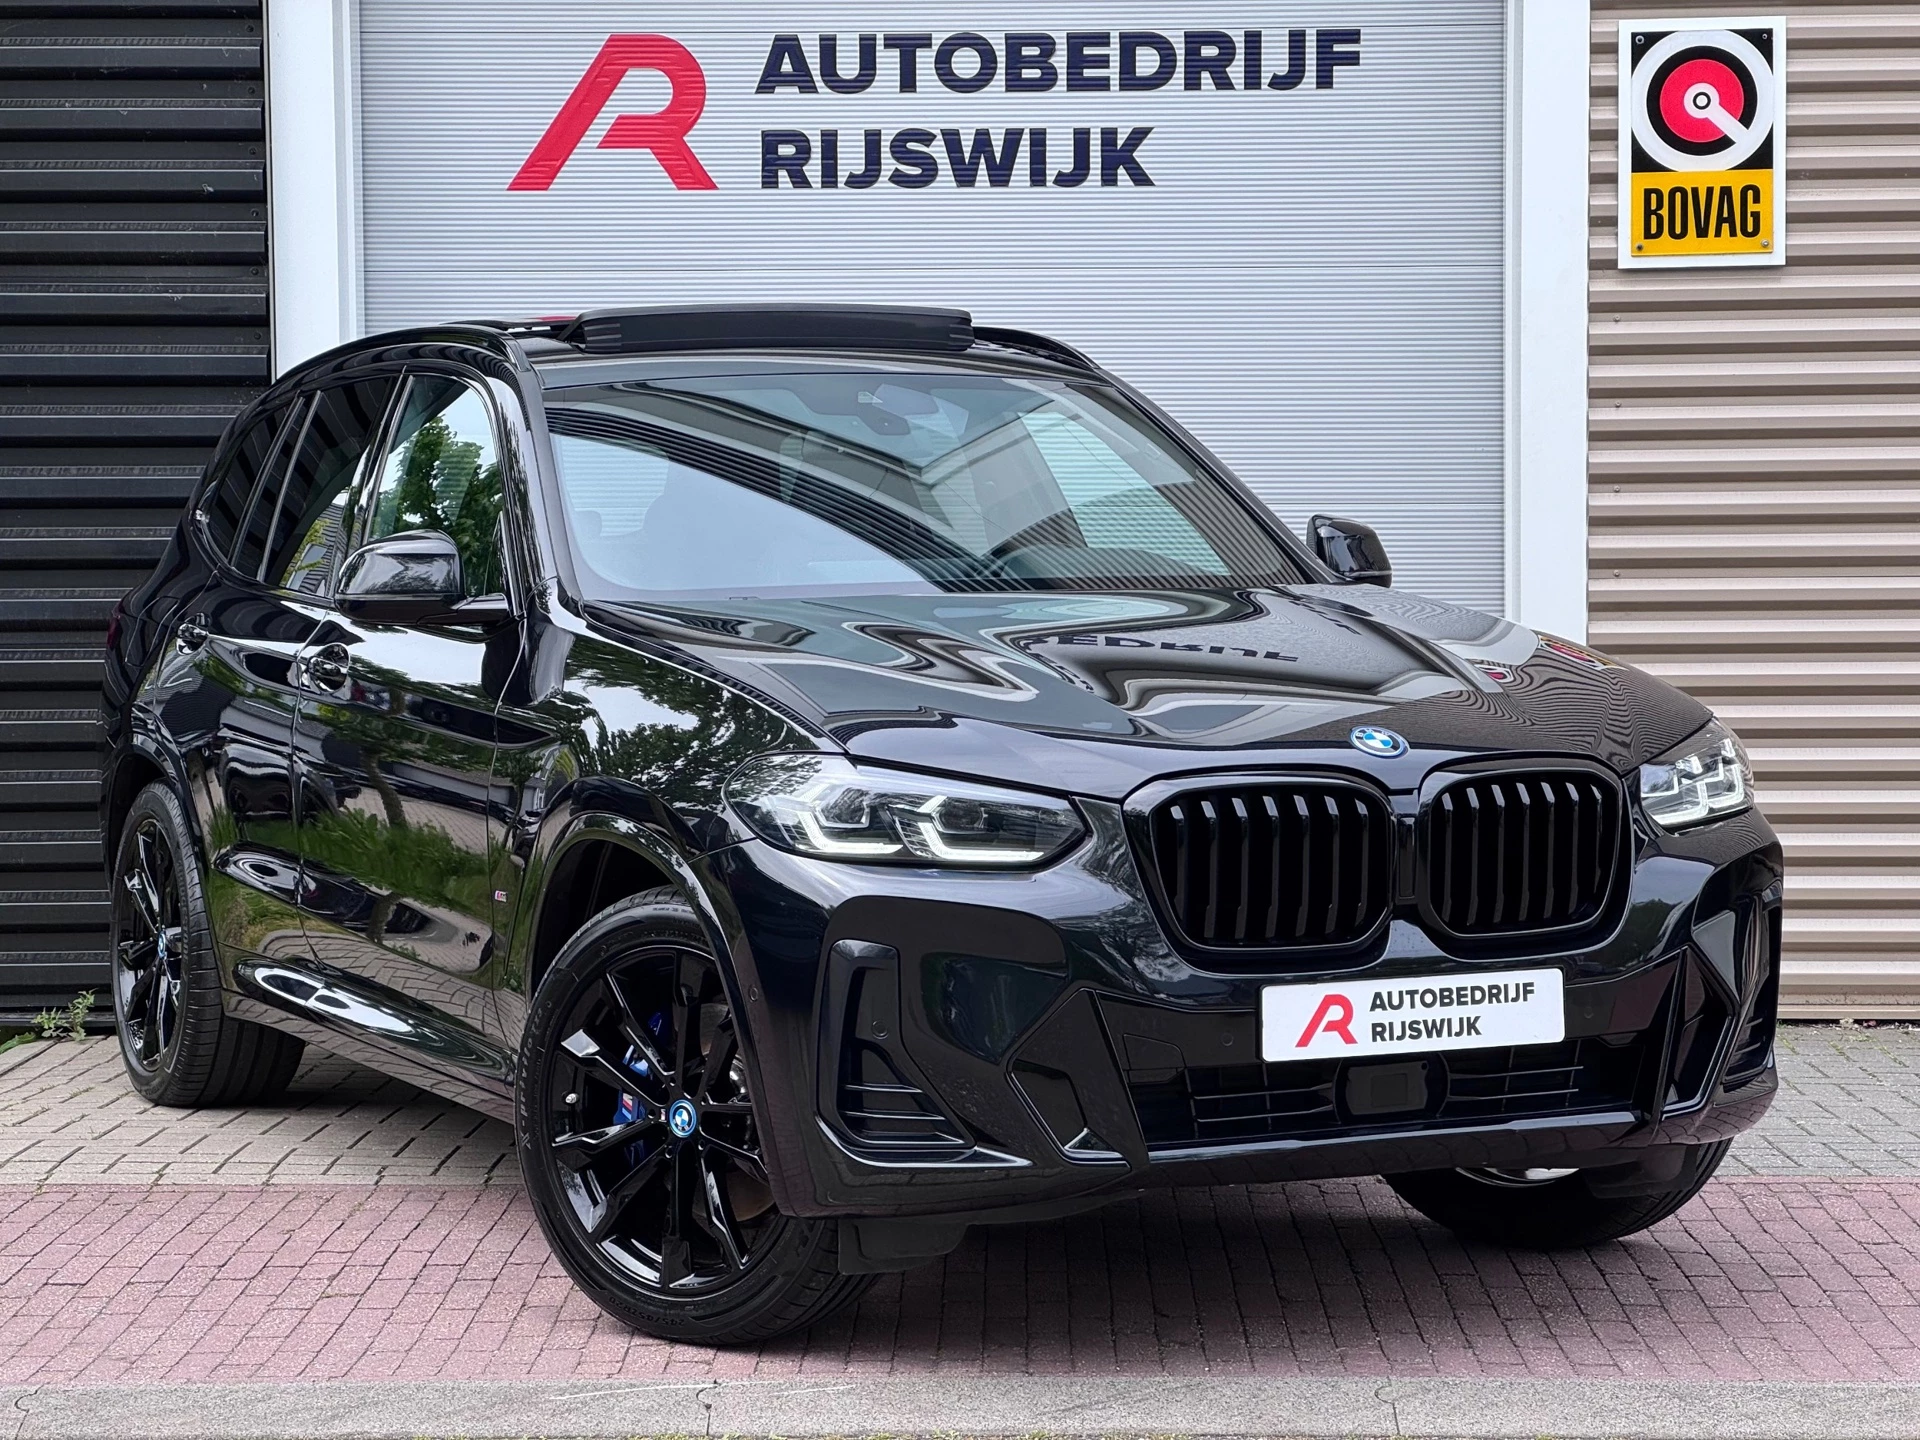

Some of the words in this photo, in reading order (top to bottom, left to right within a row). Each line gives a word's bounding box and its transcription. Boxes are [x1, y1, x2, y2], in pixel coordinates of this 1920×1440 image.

[755, 28, 1363, 95] AUTOBEDRIJF
[759, 126, 1158, 190] RIJSWIJK
[1643, 184, 1761, 240] BOVAG
[1369, 982, 1536, 1012] AUTOBEDRIJF
[1371, 1016, 1482, 1042] RIJSWIJK
